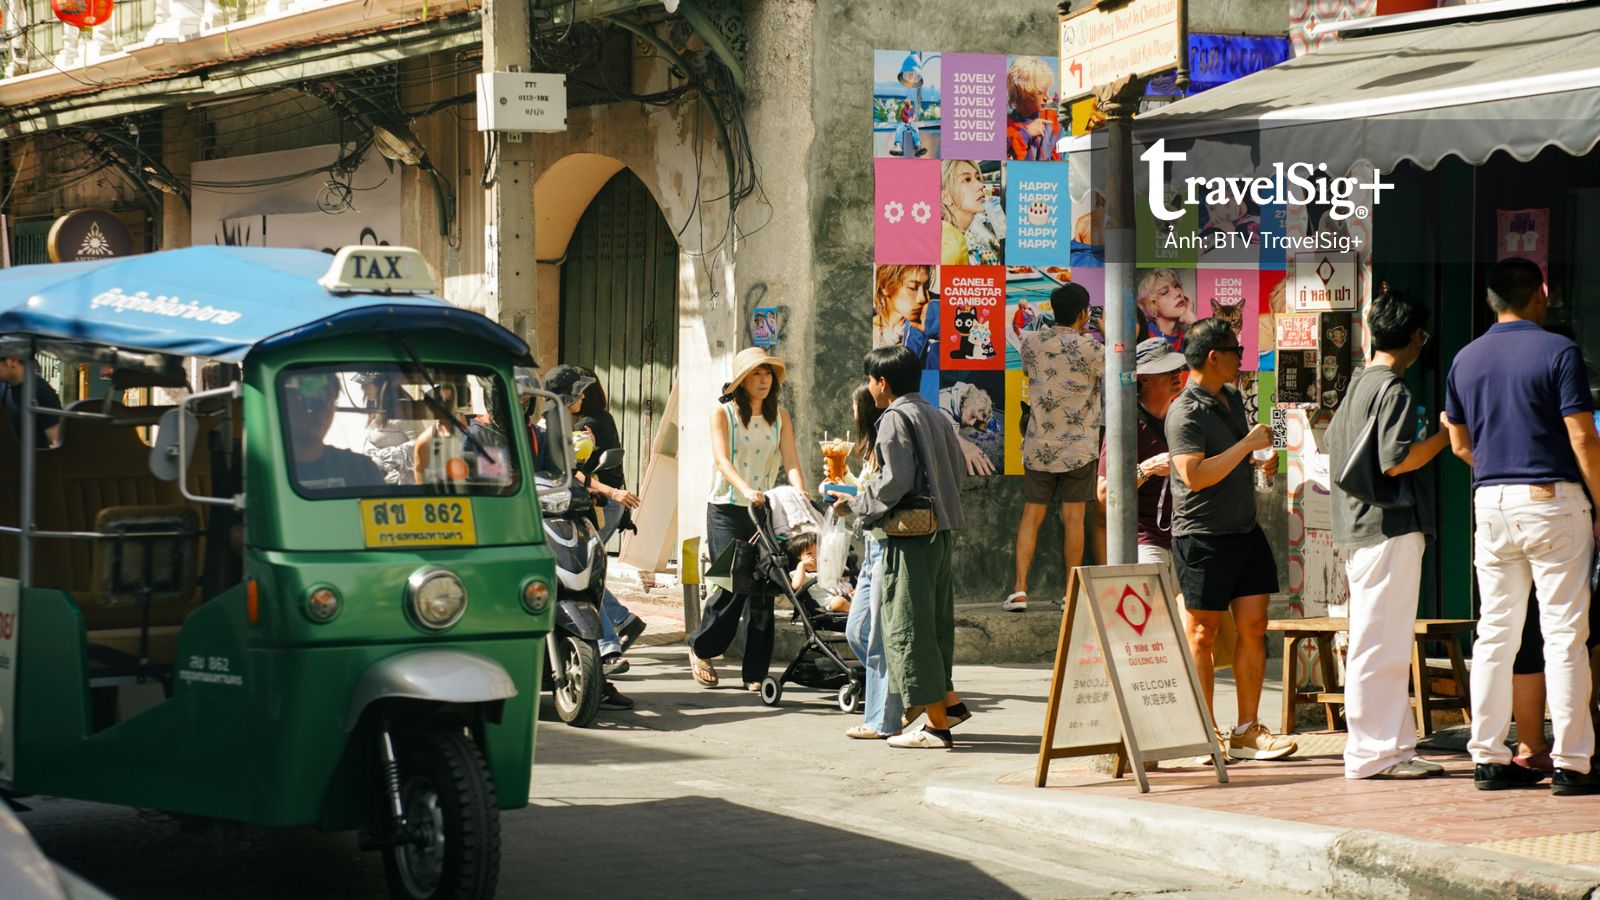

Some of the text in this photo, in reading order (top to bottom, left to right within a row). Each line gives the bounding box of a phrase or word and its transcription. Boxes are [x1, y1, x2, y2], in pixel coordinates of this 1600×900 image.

[953, 73, 995, 83] 10VELY
[953, 85, 995, 94] 10VELY
[953, 96, 995, 106] 10VELY
[953, 108, 995, 118] 10VELY
[953, 120, 995, 129] 10VELY
[953, 131, 995, 141] 10VELY
[1019, 181, 1058, 191] HAPPY
[1019, 193, 1058, 203] HAPPY
[1019, 227, 1058, 237] HAPPY
[1018, 238, 1057, 248] HAPPY
[952, 277, 994, 286] CANELE
[1215, 278, 1242, 286] LEON
[944, 287, 1002, 296] CANASTAR
[1215, 287, 1242, 295] LEON
[949, 297, 997, 306] CANIBOO
[424, 502, 463, 523] 862
[379, 531, 463, 544] กรุงเทพมหานคร
[1138, 657, 1154, 665] LONG
[1155, 656, 1168, 664] BAO
[1132, 679, 1178, 691] WELCOME
[1142, 692, 1177, 706] 欢迎光临
